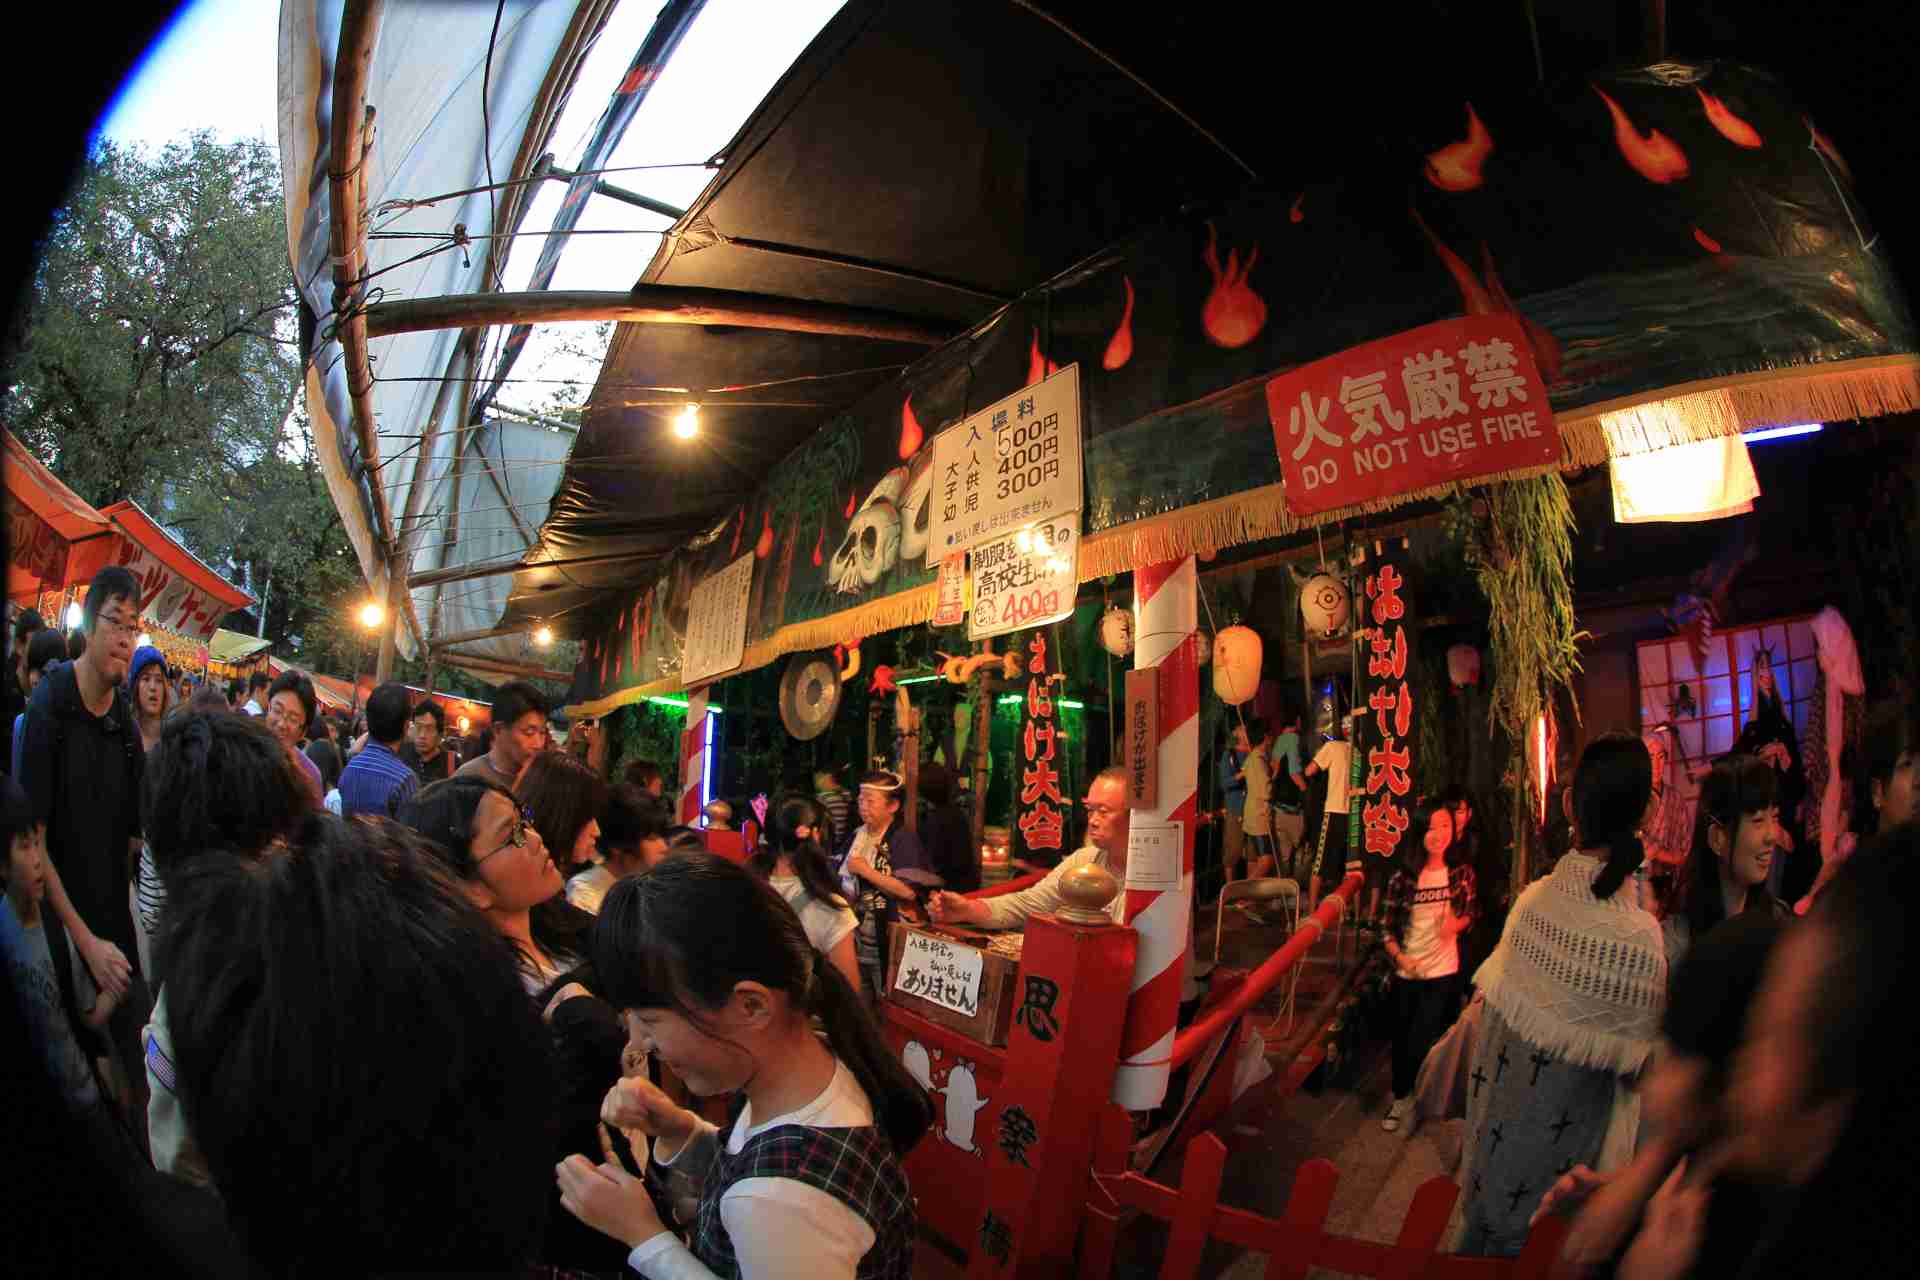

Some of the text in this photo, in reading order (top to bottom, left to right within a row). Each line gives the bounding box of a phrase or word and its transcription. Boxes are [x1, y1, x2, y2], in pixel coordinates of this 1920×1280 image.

[965, 398, 1037, 448] 入場料
[1289, 338, 1527, 460] 火気厳禁
[997, 412, 1059, 458] 500円
[1302, 411, 1543, 490] DO NOT USE FIRE
[943, 434, 1059, 502] 子供 400円
[943, 458, 1059, 523] 幼児 300円
[1001, 589, 1058, 627] 400円
